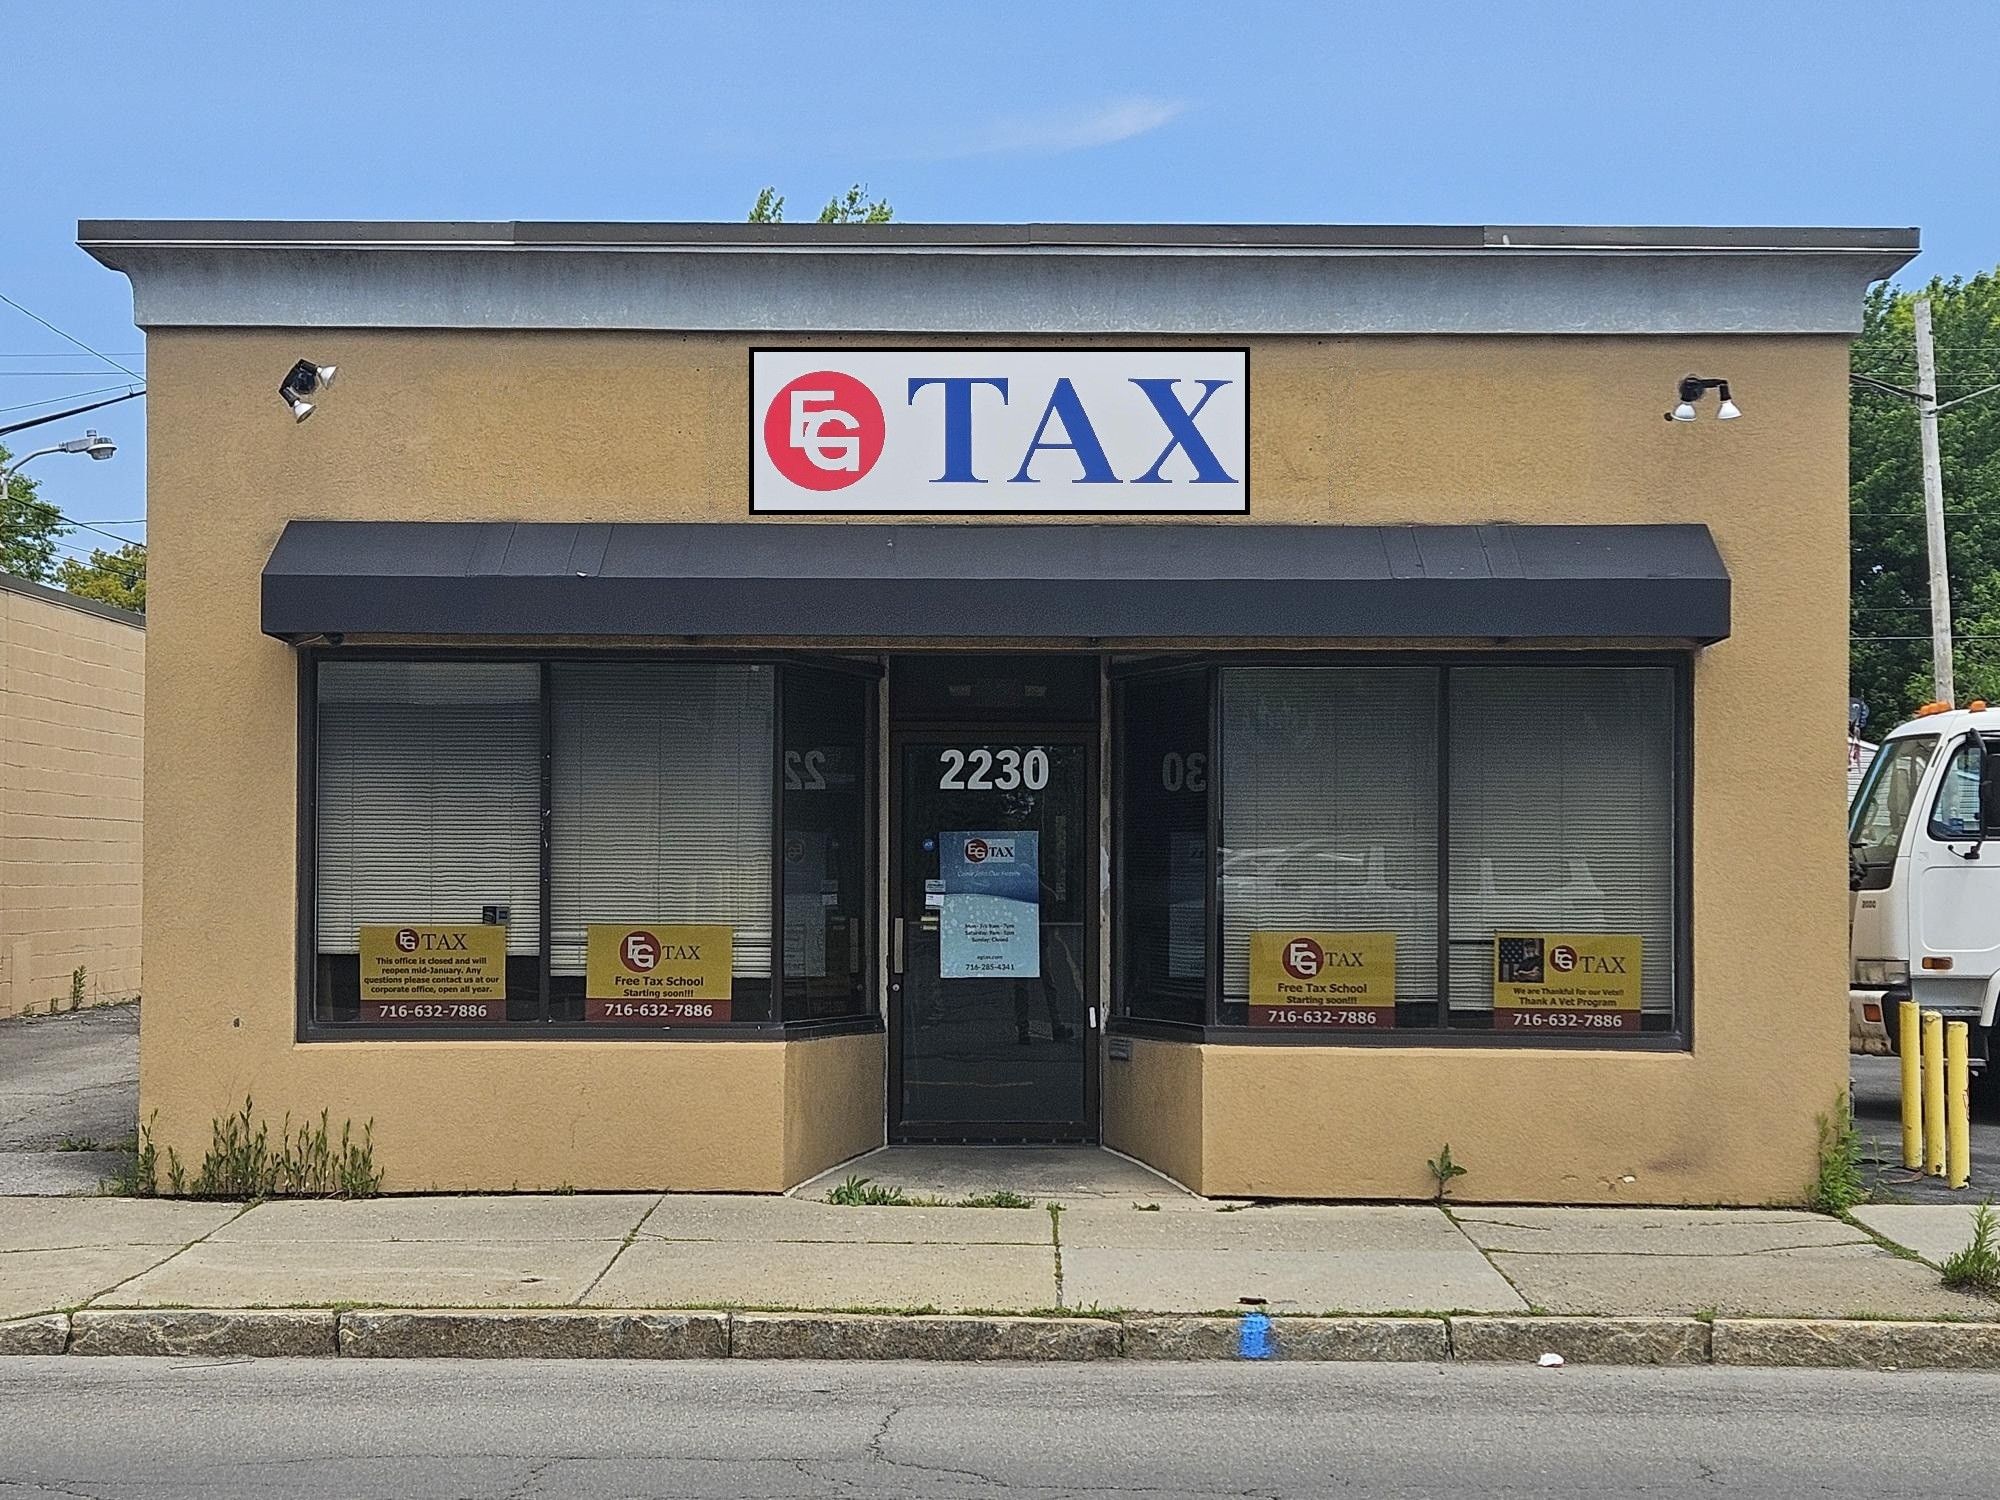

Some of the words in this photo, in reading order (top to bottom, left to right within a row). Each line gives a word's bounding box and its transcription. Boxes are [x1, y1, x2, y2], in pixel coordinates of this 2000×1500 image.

[789, 390, 861, 472] EG
[907, 377, 1239, 484] TAX
[939, 749, 1050, 790] 2230
[968, 842, 986, 859] EG
[988, 846, 1014, 858] TAX
[400, 931, 416, 950] EG
[421, 933, 468, 950] TAX
[627, 937, 654, 968] EG
[661, 945, 701, 960] TAX
[1290, 943, 1317, 975] EG
[1325, 952, 1364, 967] TAX
[376, 957, 393, 965] This
[394, 957, 417, 965] office
[419, 957, 426, 965] is
[428, 957, 453, 965] closed
[455, 957, 470, 965] and
[472, 957, 487, 965] will
[1554, 948, 1573, 970] EG
[1579, 956, 1626, 974] TAX
[411, 967, 463, 975] mid-January.
[466, 967, 481, 975] Any
[364, 977, 402, 985] questions
[404, 976, 430, 985] please
[615, 976, 640, 986] Free
[643, 976, 663, 986] Tax
[666, 976, 704, 986] School
[371, 986, 410, 994] corporate
[412, 986, 436, 994] office,
[438, 986, 458, 994] open
[460, 986, 469, 994] all
[472, 986, 492, 995] year.
[623, 989, 660, 998] Starting
[663, 989, 694, 998] soon!!!
[1278, 983, 1303, 993] Free
[1306, 983, 1326, 993] Tax
[1329, 983, 1367, 994] School
[1513, 987, 1526, 995] We
[1541, 987, 1574, 995] Thankful
[1576, 987, 1587, 995] for
[1286, 996, 1322, 1005] Starting
[1325, 996, 1358, 1005] soon!!!
[1520, 997, 1547, 1006] Thank
[1549, 998, 1558, 1006] A
[1559, 998, 1575, 1006] Vet
[1577, 998, 1617, 1008] Program
[379, 1005, 487, 1018] 716-632-7886
[604, 1003, 713, 1017] 716-632-7886
[1268, 1010, 1377, 1024] 716-632-7886
[1513, 1013, 1622, 1027] 716-632-7886
